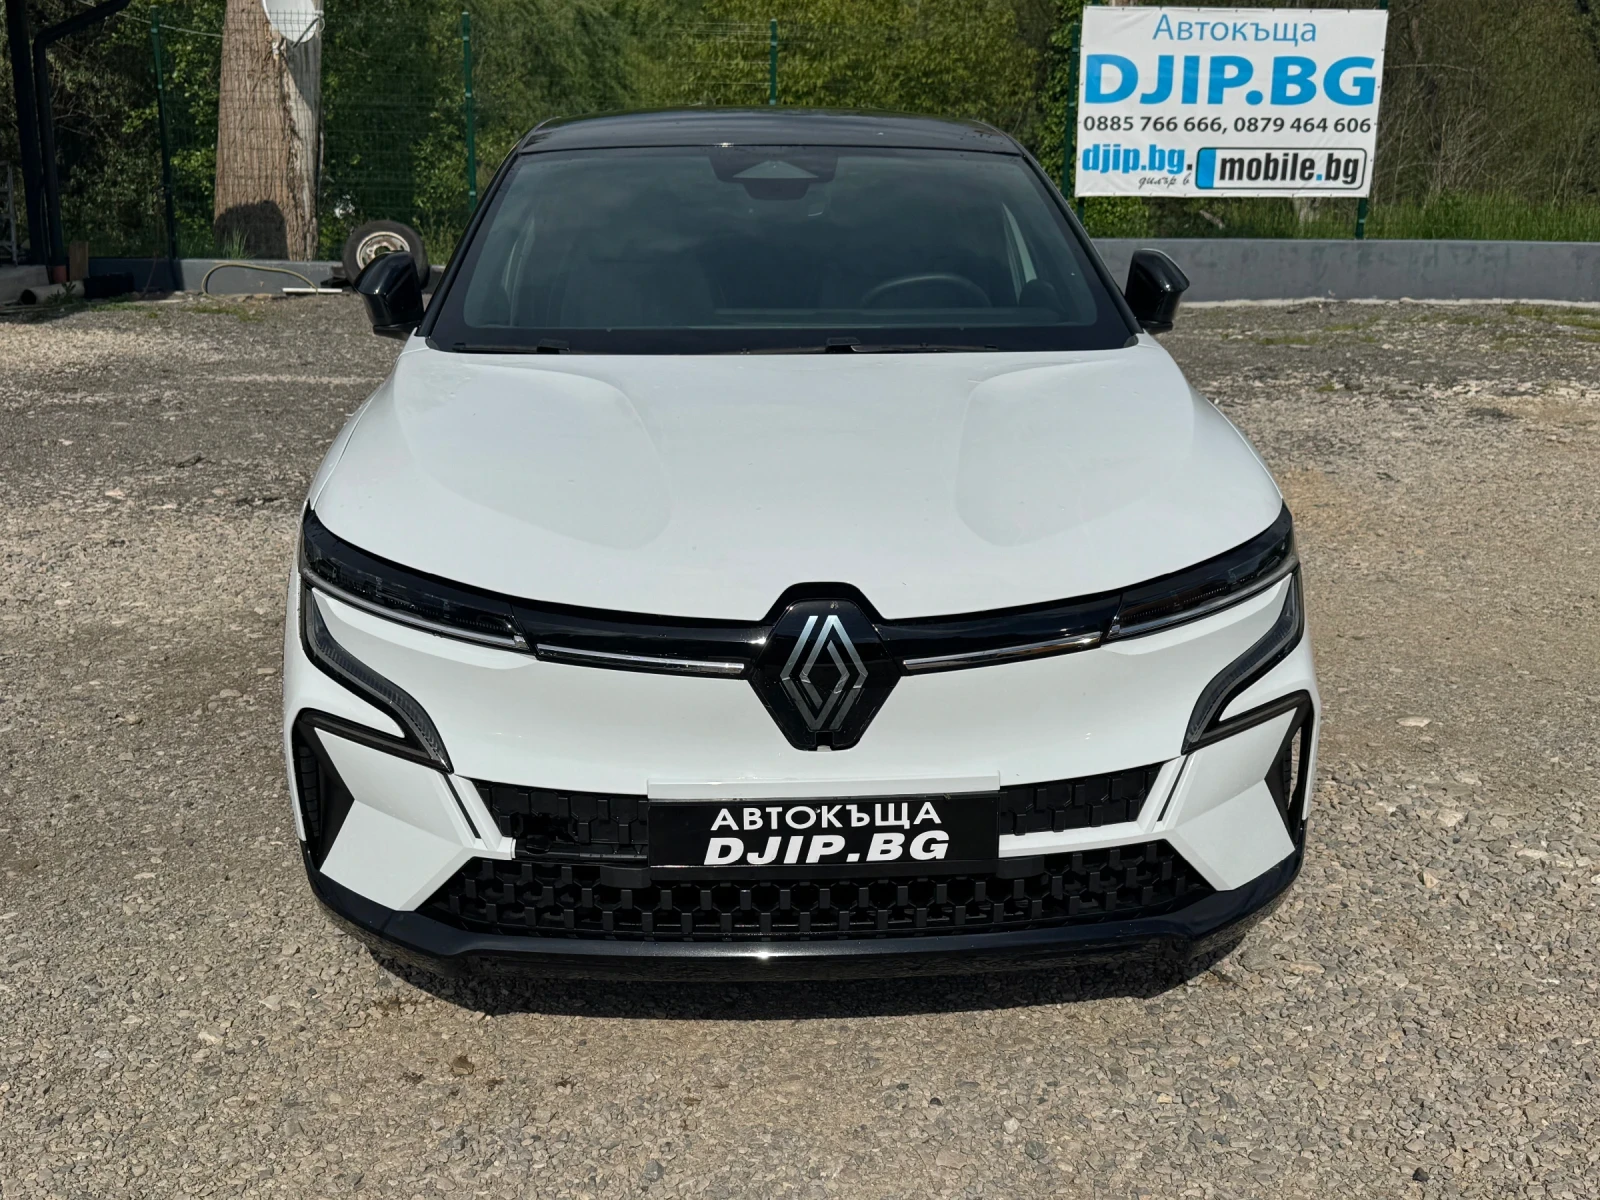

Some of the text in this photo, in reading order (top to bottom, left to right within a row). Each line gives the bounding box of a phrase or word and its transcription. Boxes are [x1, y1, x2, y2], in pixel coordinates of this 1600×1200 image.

[1152, 14, 1316, 47] Автокъща
[1084, 54, 1376, 106] DJIP.BG
[1083, 116, 1371, 135] 0885 766 666, 0879 464 606
[1219, 152, 1359, 185] mobile.bg
[710, 801, 942, 831] АВТОКЪЩА
[703, 829, 950, 866] DJIP.BG
